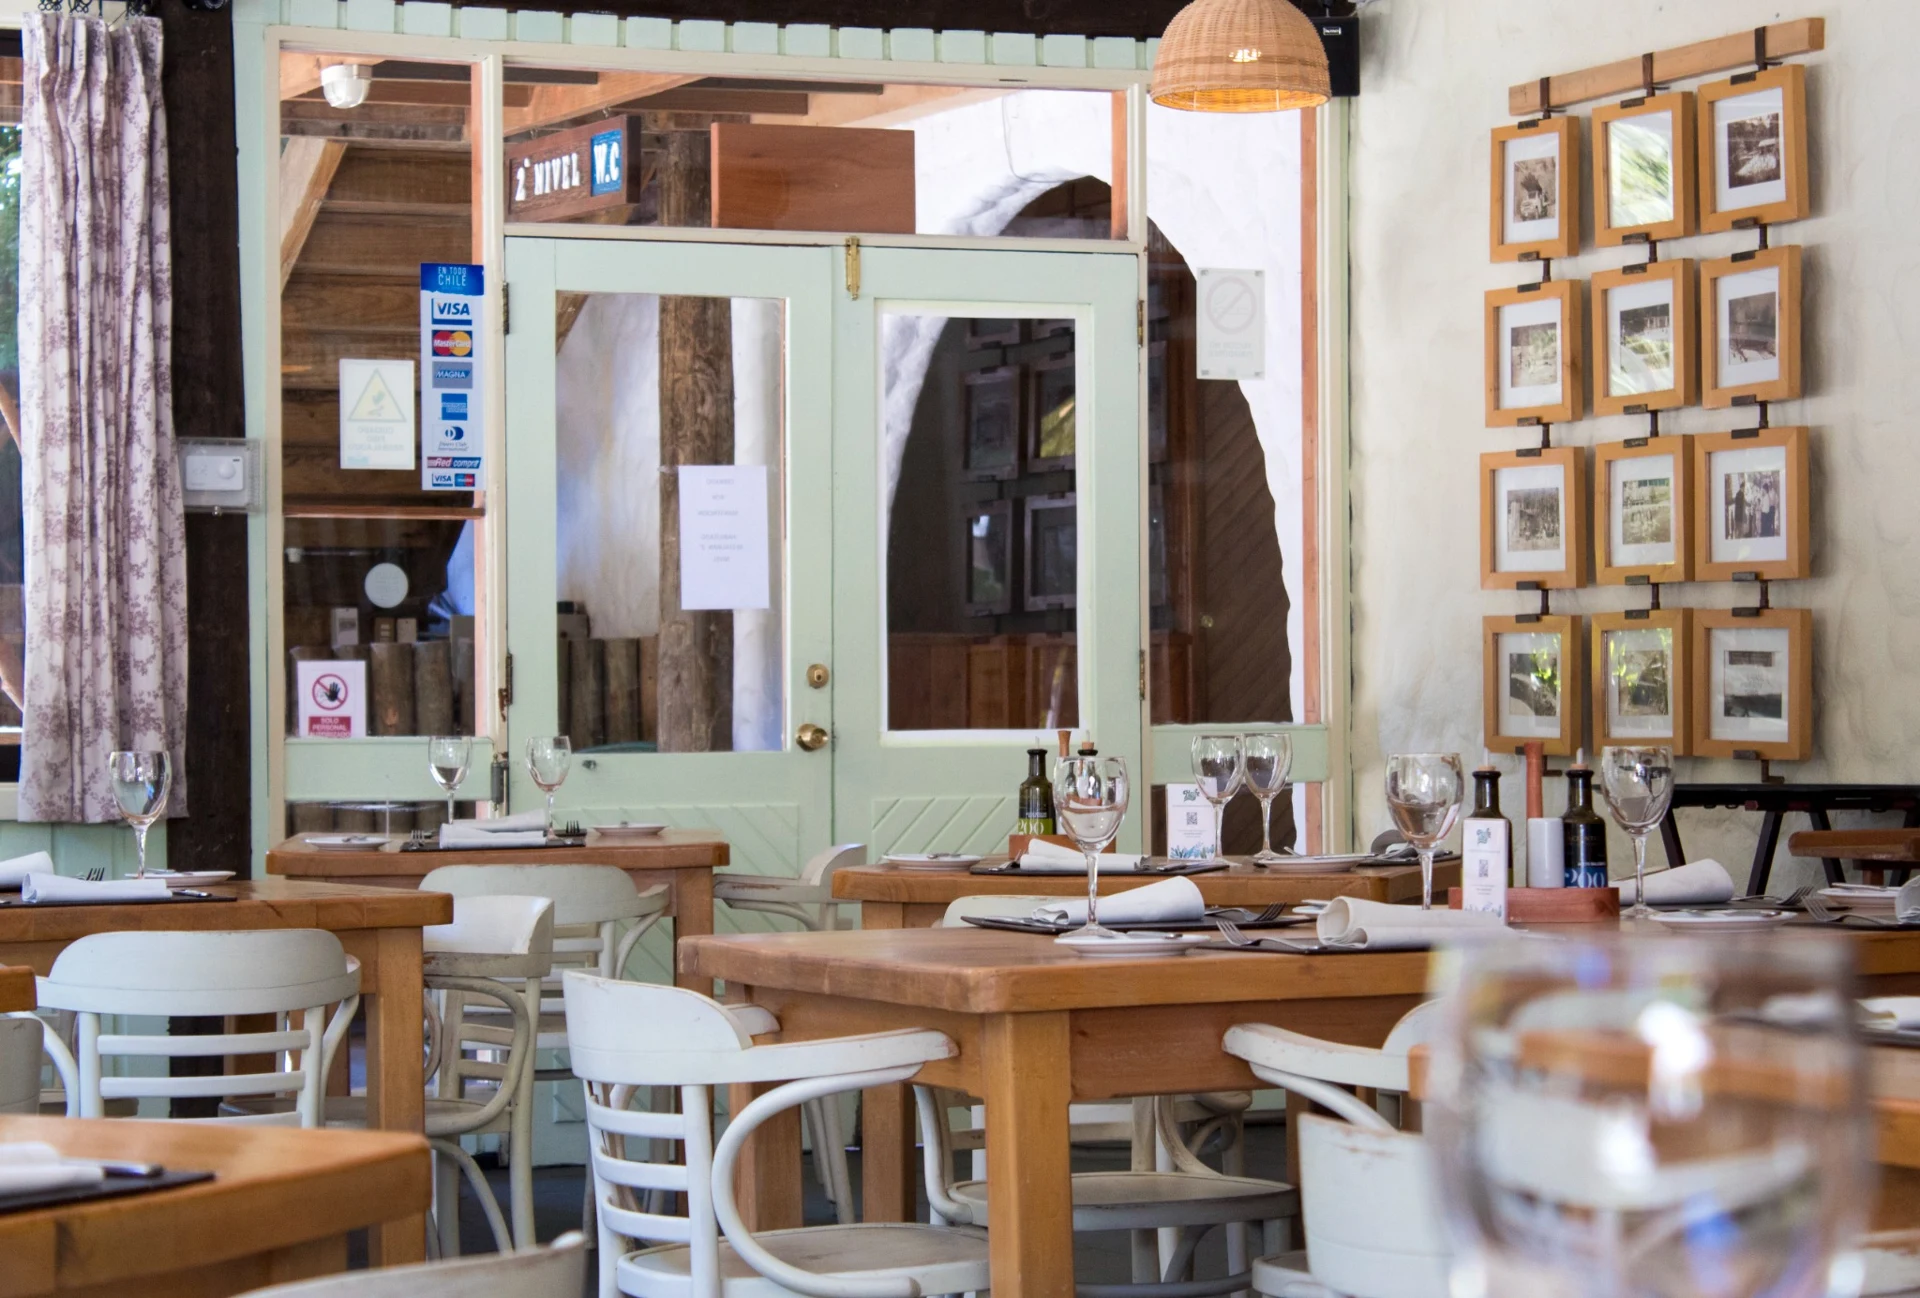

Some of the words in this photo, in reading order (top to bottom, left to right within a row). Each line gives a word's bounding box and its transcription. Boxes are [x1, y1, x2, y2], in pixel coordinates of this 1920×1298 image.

[534, 152, 580, 196] NIVEL
[437, 266, 447, 275] EN
[438, 274, 467, 287] CHILE
[437, 302, 470, 316] VISA
[436, 370, 467, 379] MAGNA
[435, 458, 452, 468] Red
[434, 475, 452, 483] VISA
[1018, 819, 1044, 835] 200
